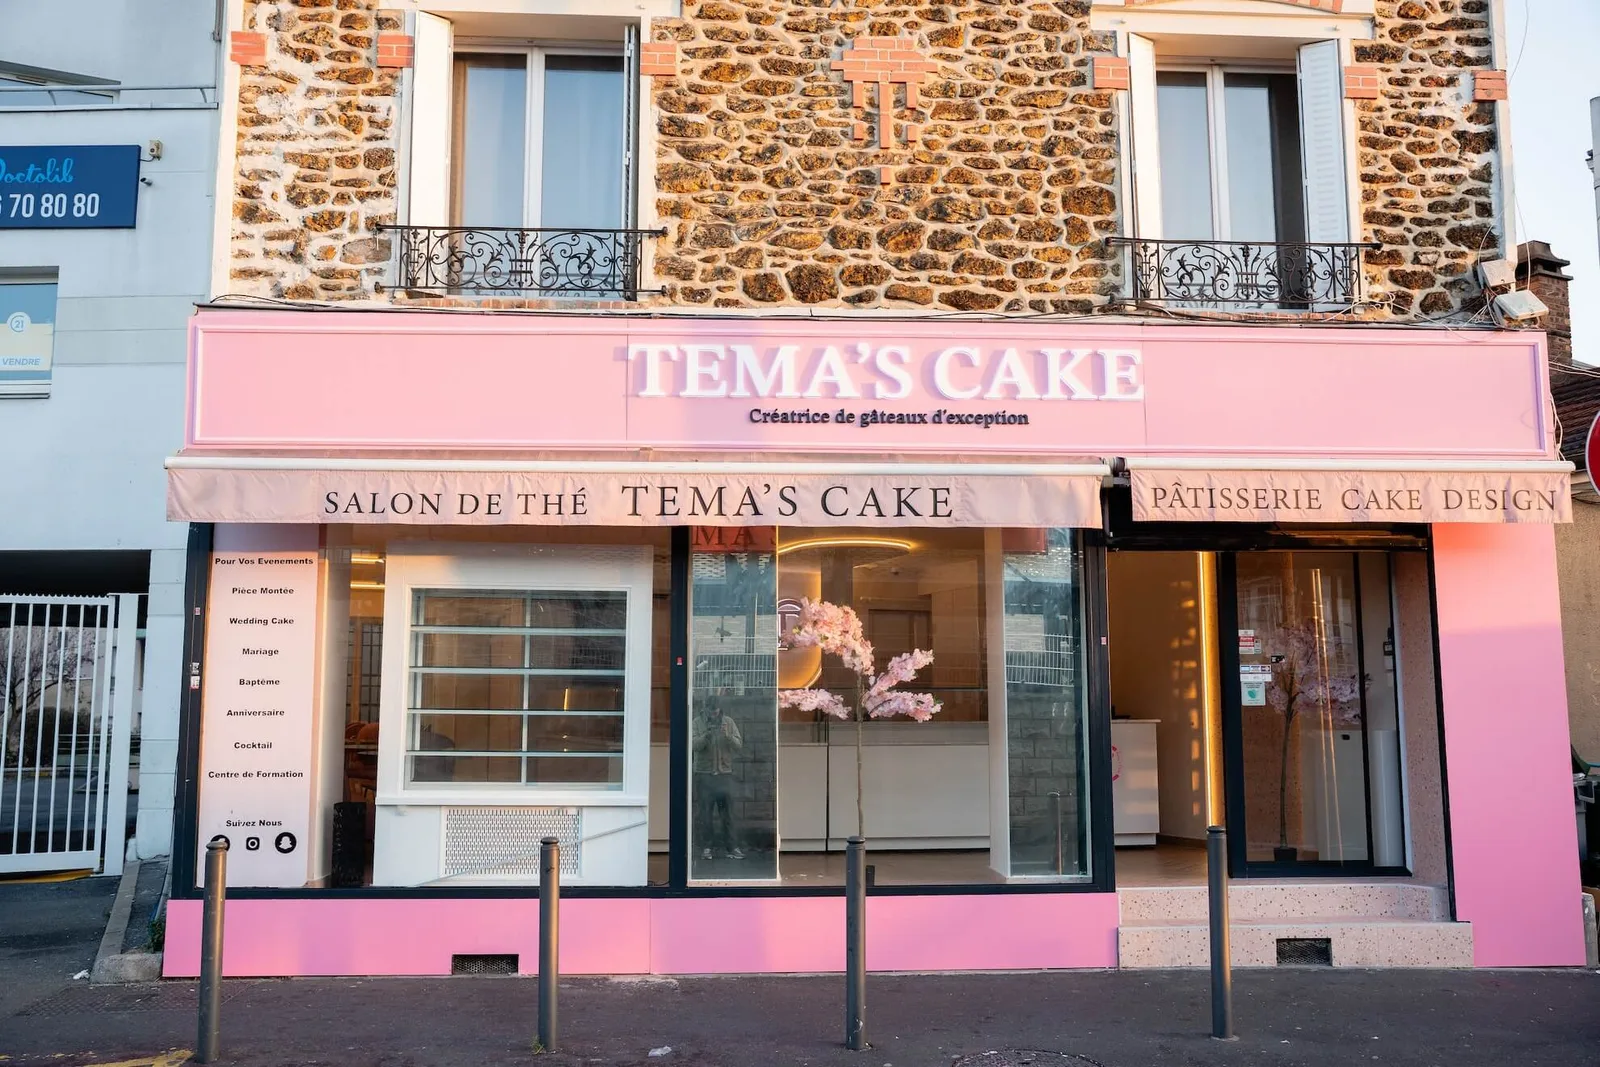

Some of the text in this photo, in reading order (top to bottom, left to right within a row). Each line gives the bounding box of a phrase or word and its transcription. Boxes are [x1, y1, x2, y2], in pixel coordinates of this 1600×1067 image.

[9, 193, 35, 218] 70
[40, 193, 67, 217] 80
[72, 193, 100, 217] 80
[2, 358, 41, 366] VENDRE
[933, 346, 1144, 401] CAKE
[749, 408, 830, 424] Créatrice
[835, 408, 855, 424] de
[860, 408, 927, 427] gâteaux
[1151, 482, 1557, 511] PÂTISSERIE CAKE DESIGN
[324, 490, 443, 516] SALON
[457, 493, 503, 516] DE
[516, 487, 588, 516] THÉ
[820, 486, 953, 518] CAKE
[214, 557, 314, 566] Pour Vos Evenements
[260, 587, 295, 595] Montée
[229, 617, 295, 626] Wedding Cake
[242, 648, 279, 657] Mariage
[226, 709, 285, 717] Anniversaire
[234, 741, 273, 750] Cocktail
[208, 771, 304, 779] Centre de Formation
[258, 819, 283, 828] Nous
